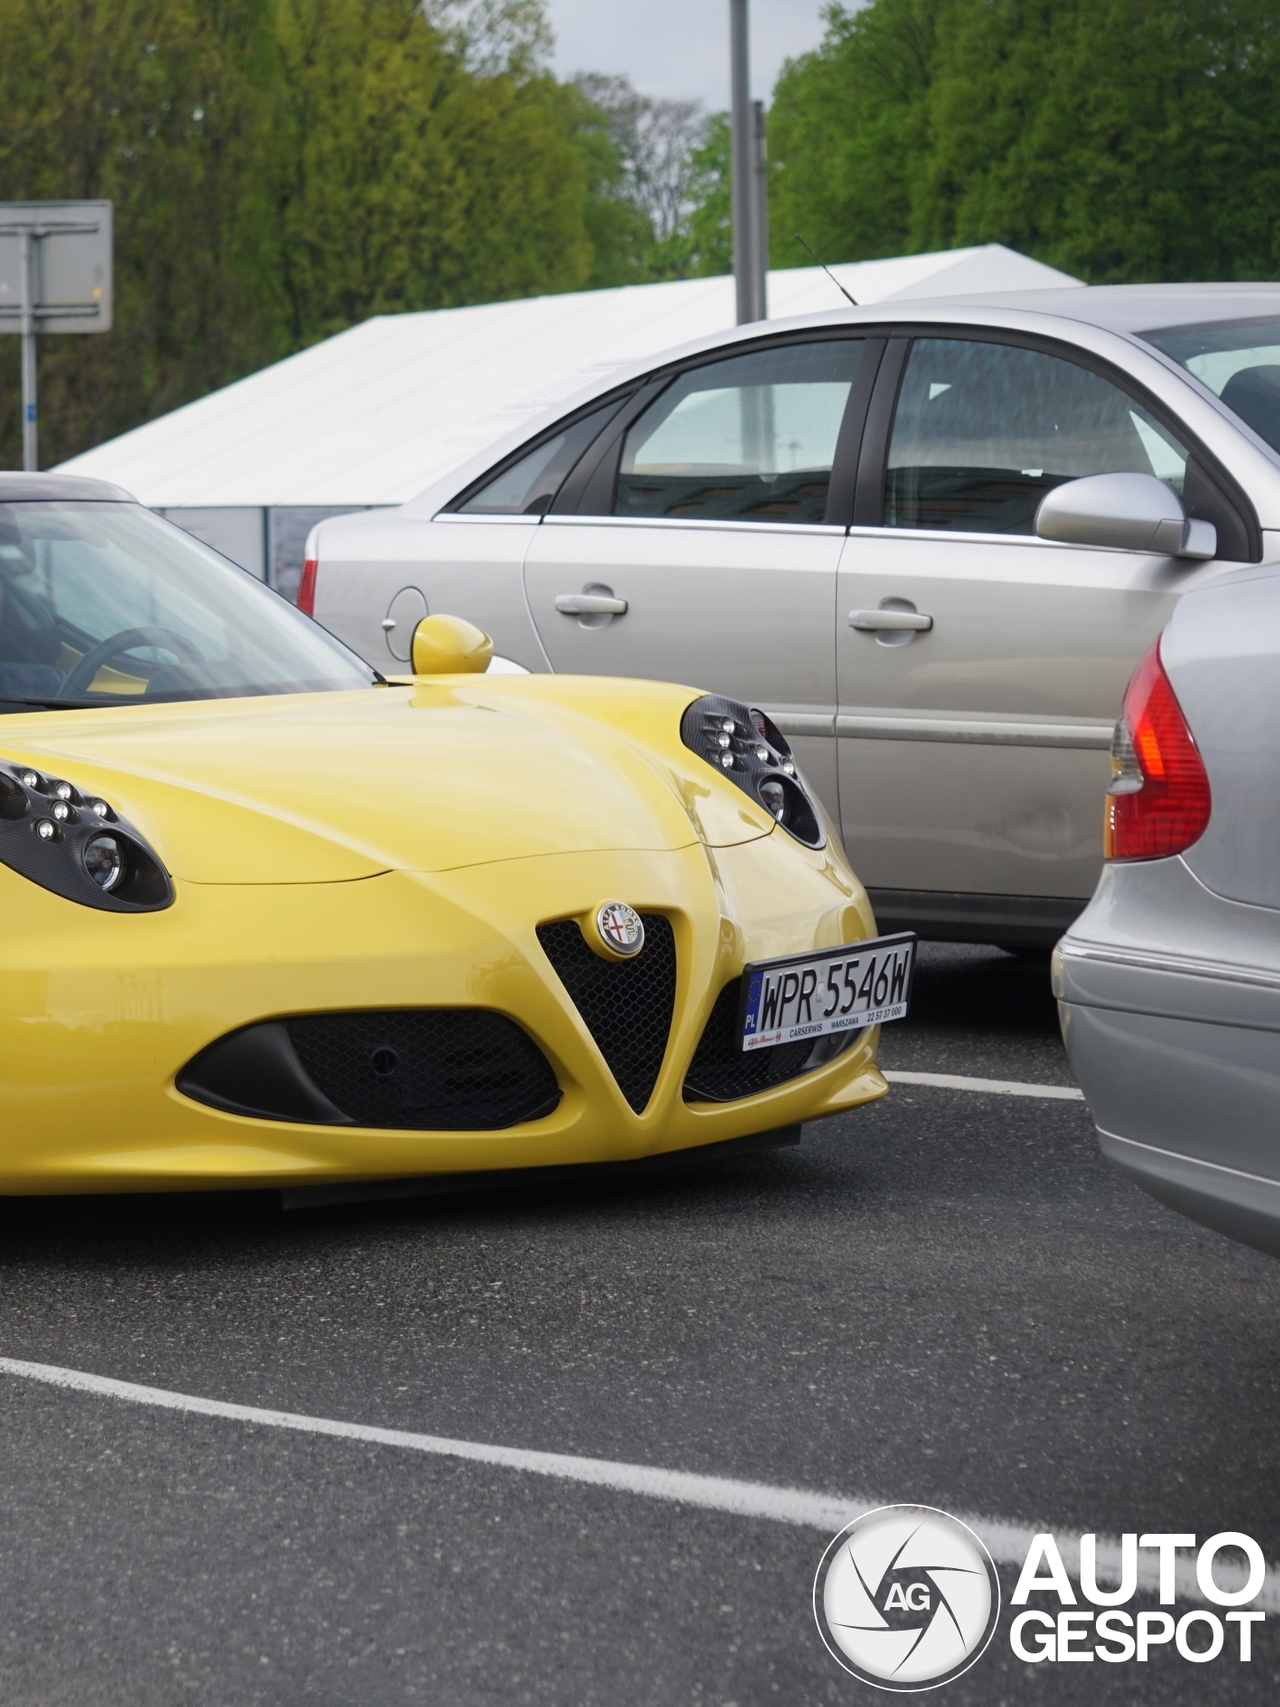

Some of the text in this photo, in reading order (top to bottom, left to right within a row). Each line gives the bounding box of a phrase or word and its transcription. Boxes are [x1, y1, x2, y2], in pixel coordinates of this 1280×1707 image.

[603, 904, 640, 930] ALFA ROMEO
[760, 950, 910, 1031] WPR 5546W
[745, 1014, 756, 1029] PL
[789, 1023, 823, 1038] CARSERWIS
[831, 1017, 859, 1029] WARSZAWA
[867, 1013, 875, 1022] 22
[875, 1010, 883, 1020] 57
[883, 1009, 891, 1018] 37
[891, 1006, 902, 1016] 000
